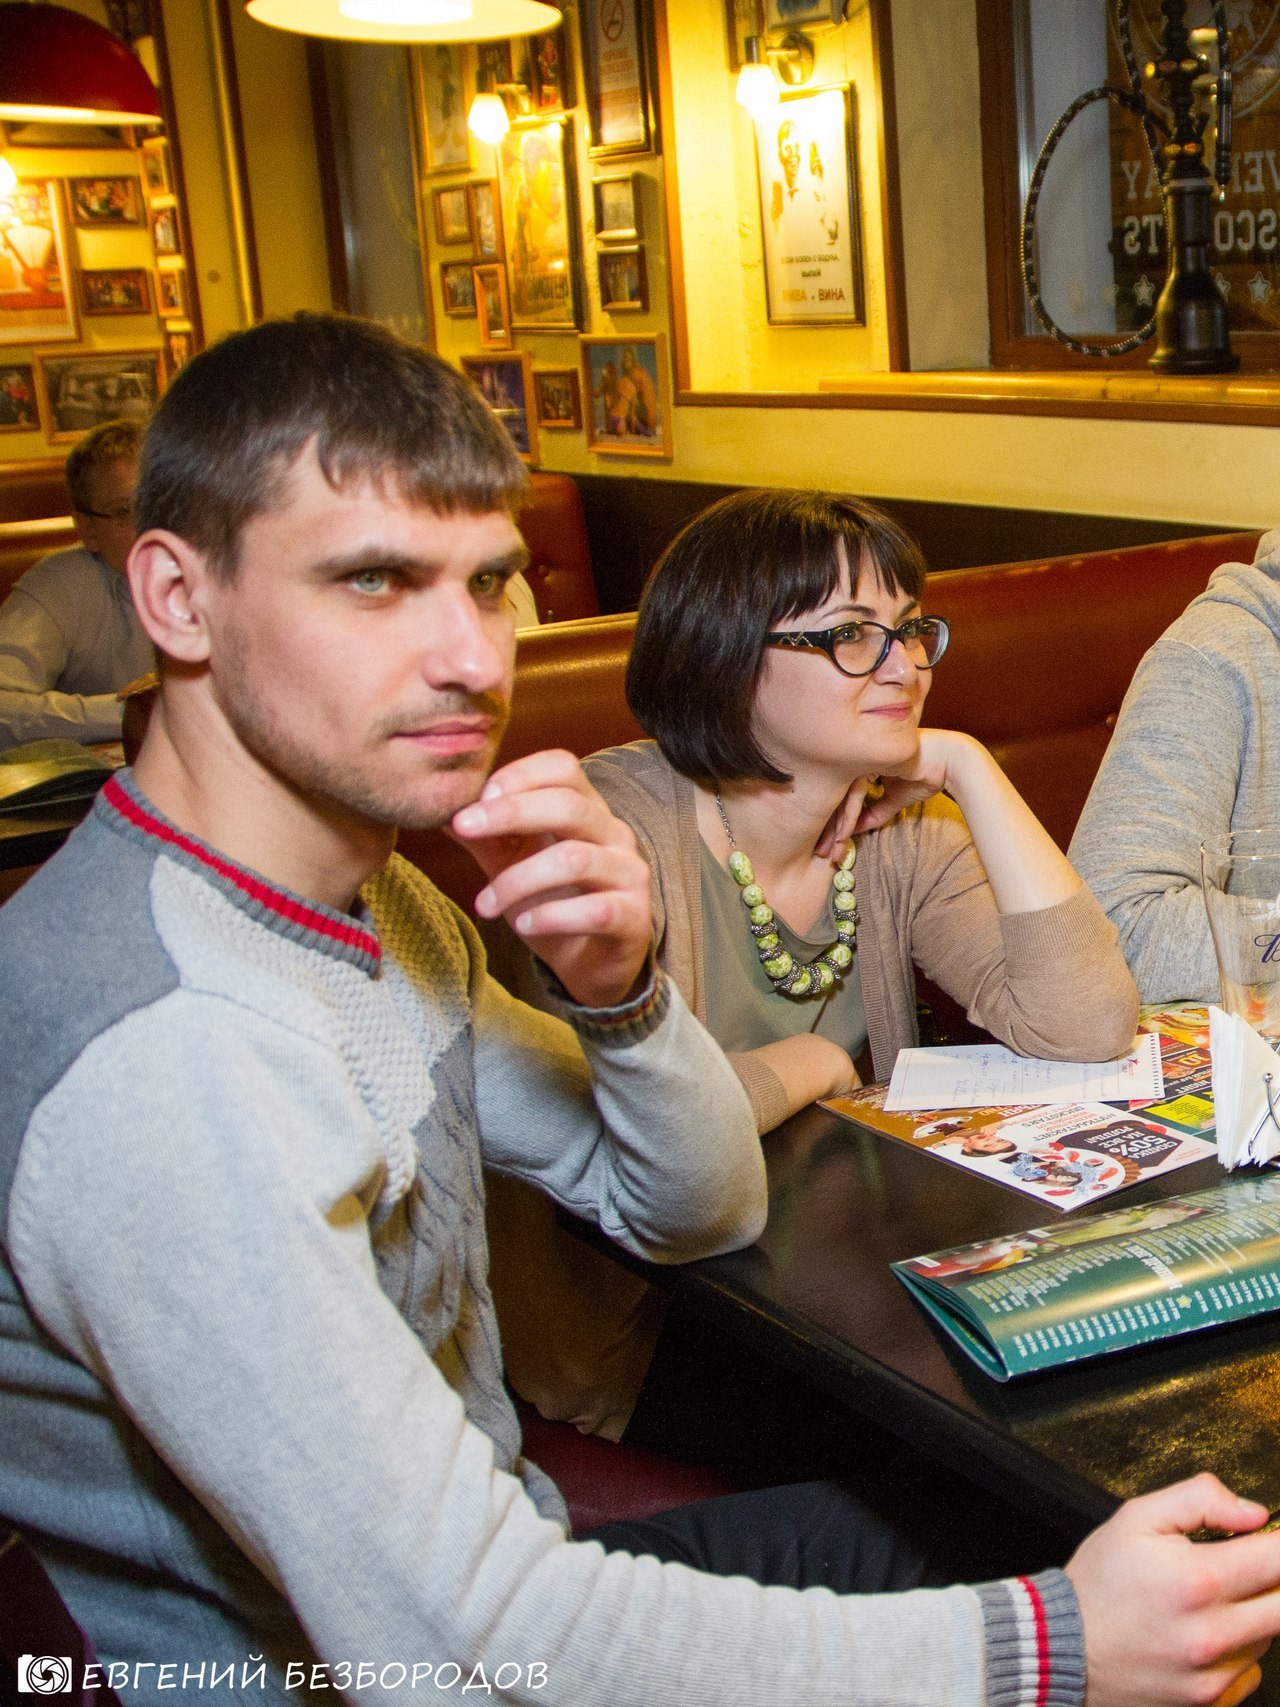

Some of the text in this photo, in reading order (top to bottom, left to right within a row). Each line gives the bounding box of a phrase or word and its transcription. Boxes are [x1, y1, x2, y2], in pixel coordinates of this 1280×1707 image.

[818, 288, 846, 301] ВИНА
[1125, 1131, 1146, 1140] НА
[1109, 1135, 1168, 1157] 50%
[1127, 1140, 1178, 1160] СКИДКА
